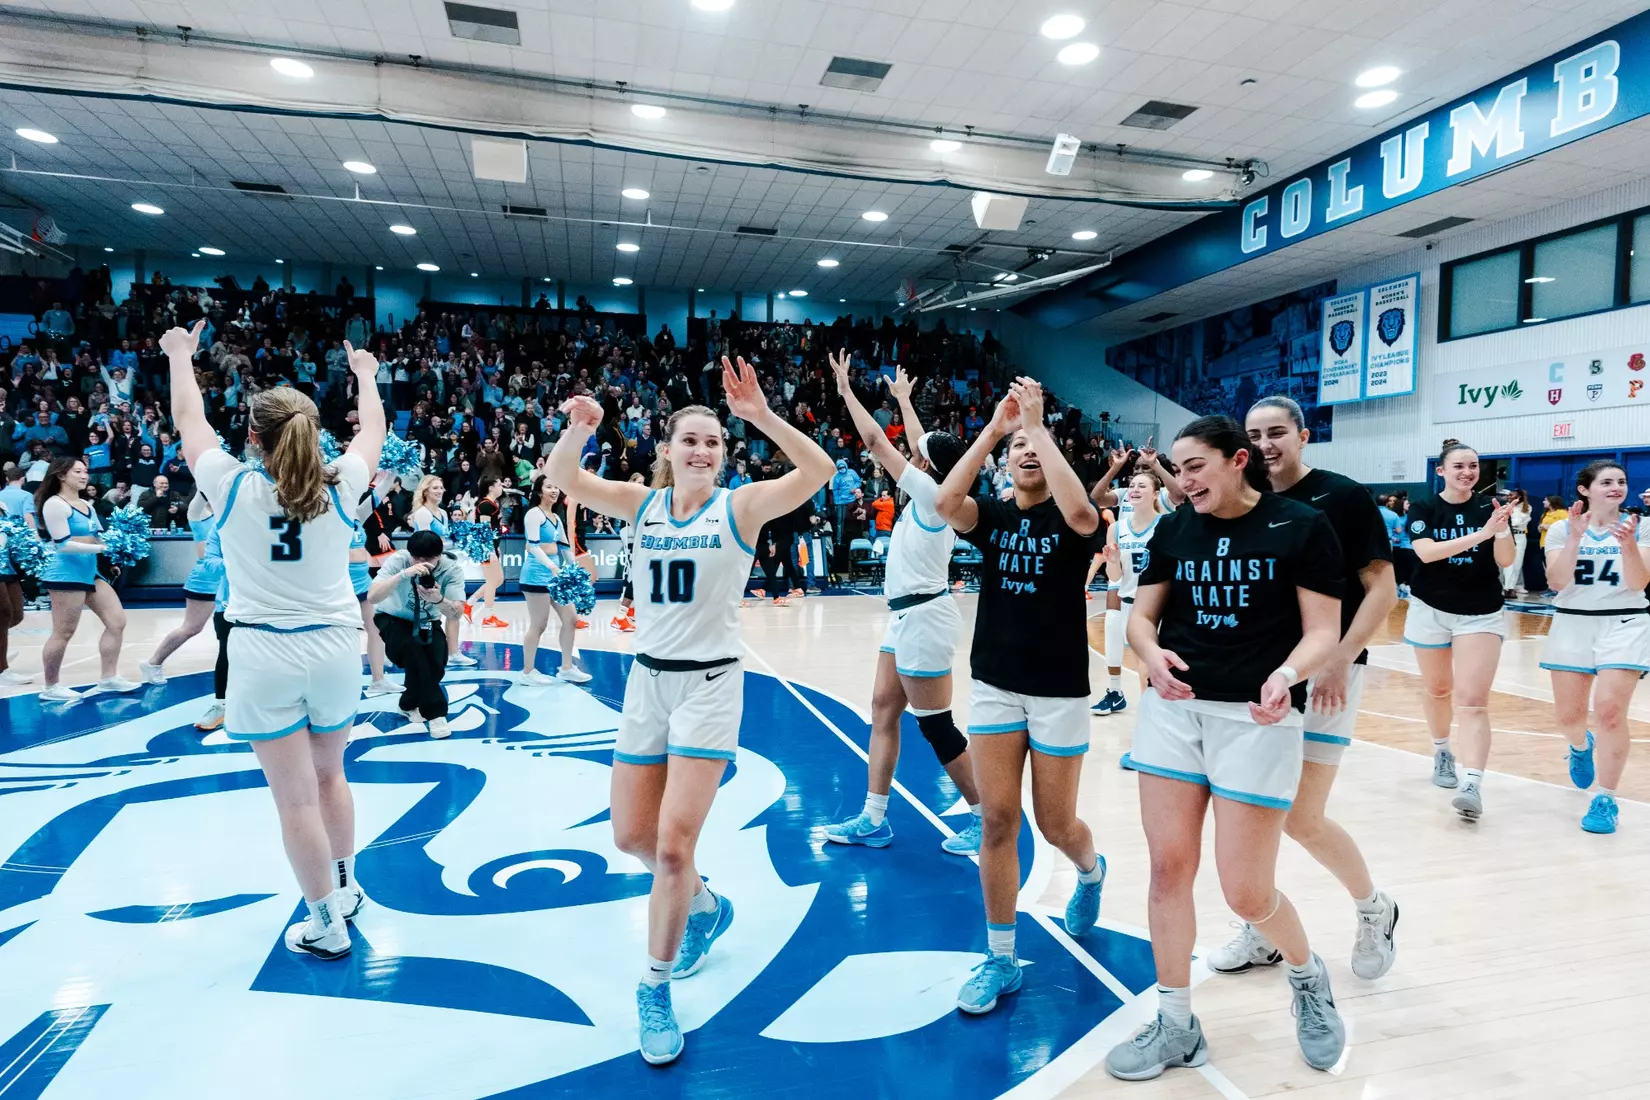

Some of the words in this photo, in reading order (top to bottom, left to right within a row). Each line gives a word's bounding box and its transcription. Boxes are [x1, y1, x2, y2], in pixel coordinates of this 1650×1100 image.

[1458, 384, 1499, 408] Ivy
[1550, 390, 1560, 402] H
[1553, 423, 1572, 437] EXIT
[1019, 518, 1031, 538] 8
[1455, 514, 1465, 525] 8
[269, 515, 303, 562] 3
[641, 534, 722, 550] COLUMBIA
[989, 528, 1060, 553] AGAINST
[1216, 537, 1231, 557] 8
[999, 552, 1044, 575] HATE
[1175, 558, 1277, 582] AGAINST
[1574, 559, 1620, 586] 24
[649, 558, 696, 604] 10
[1001, 577, 1023, 595] Ivy
[1192, 585, 1250, 607] HATE
[1196, 610, 1223, 629] Ivy
